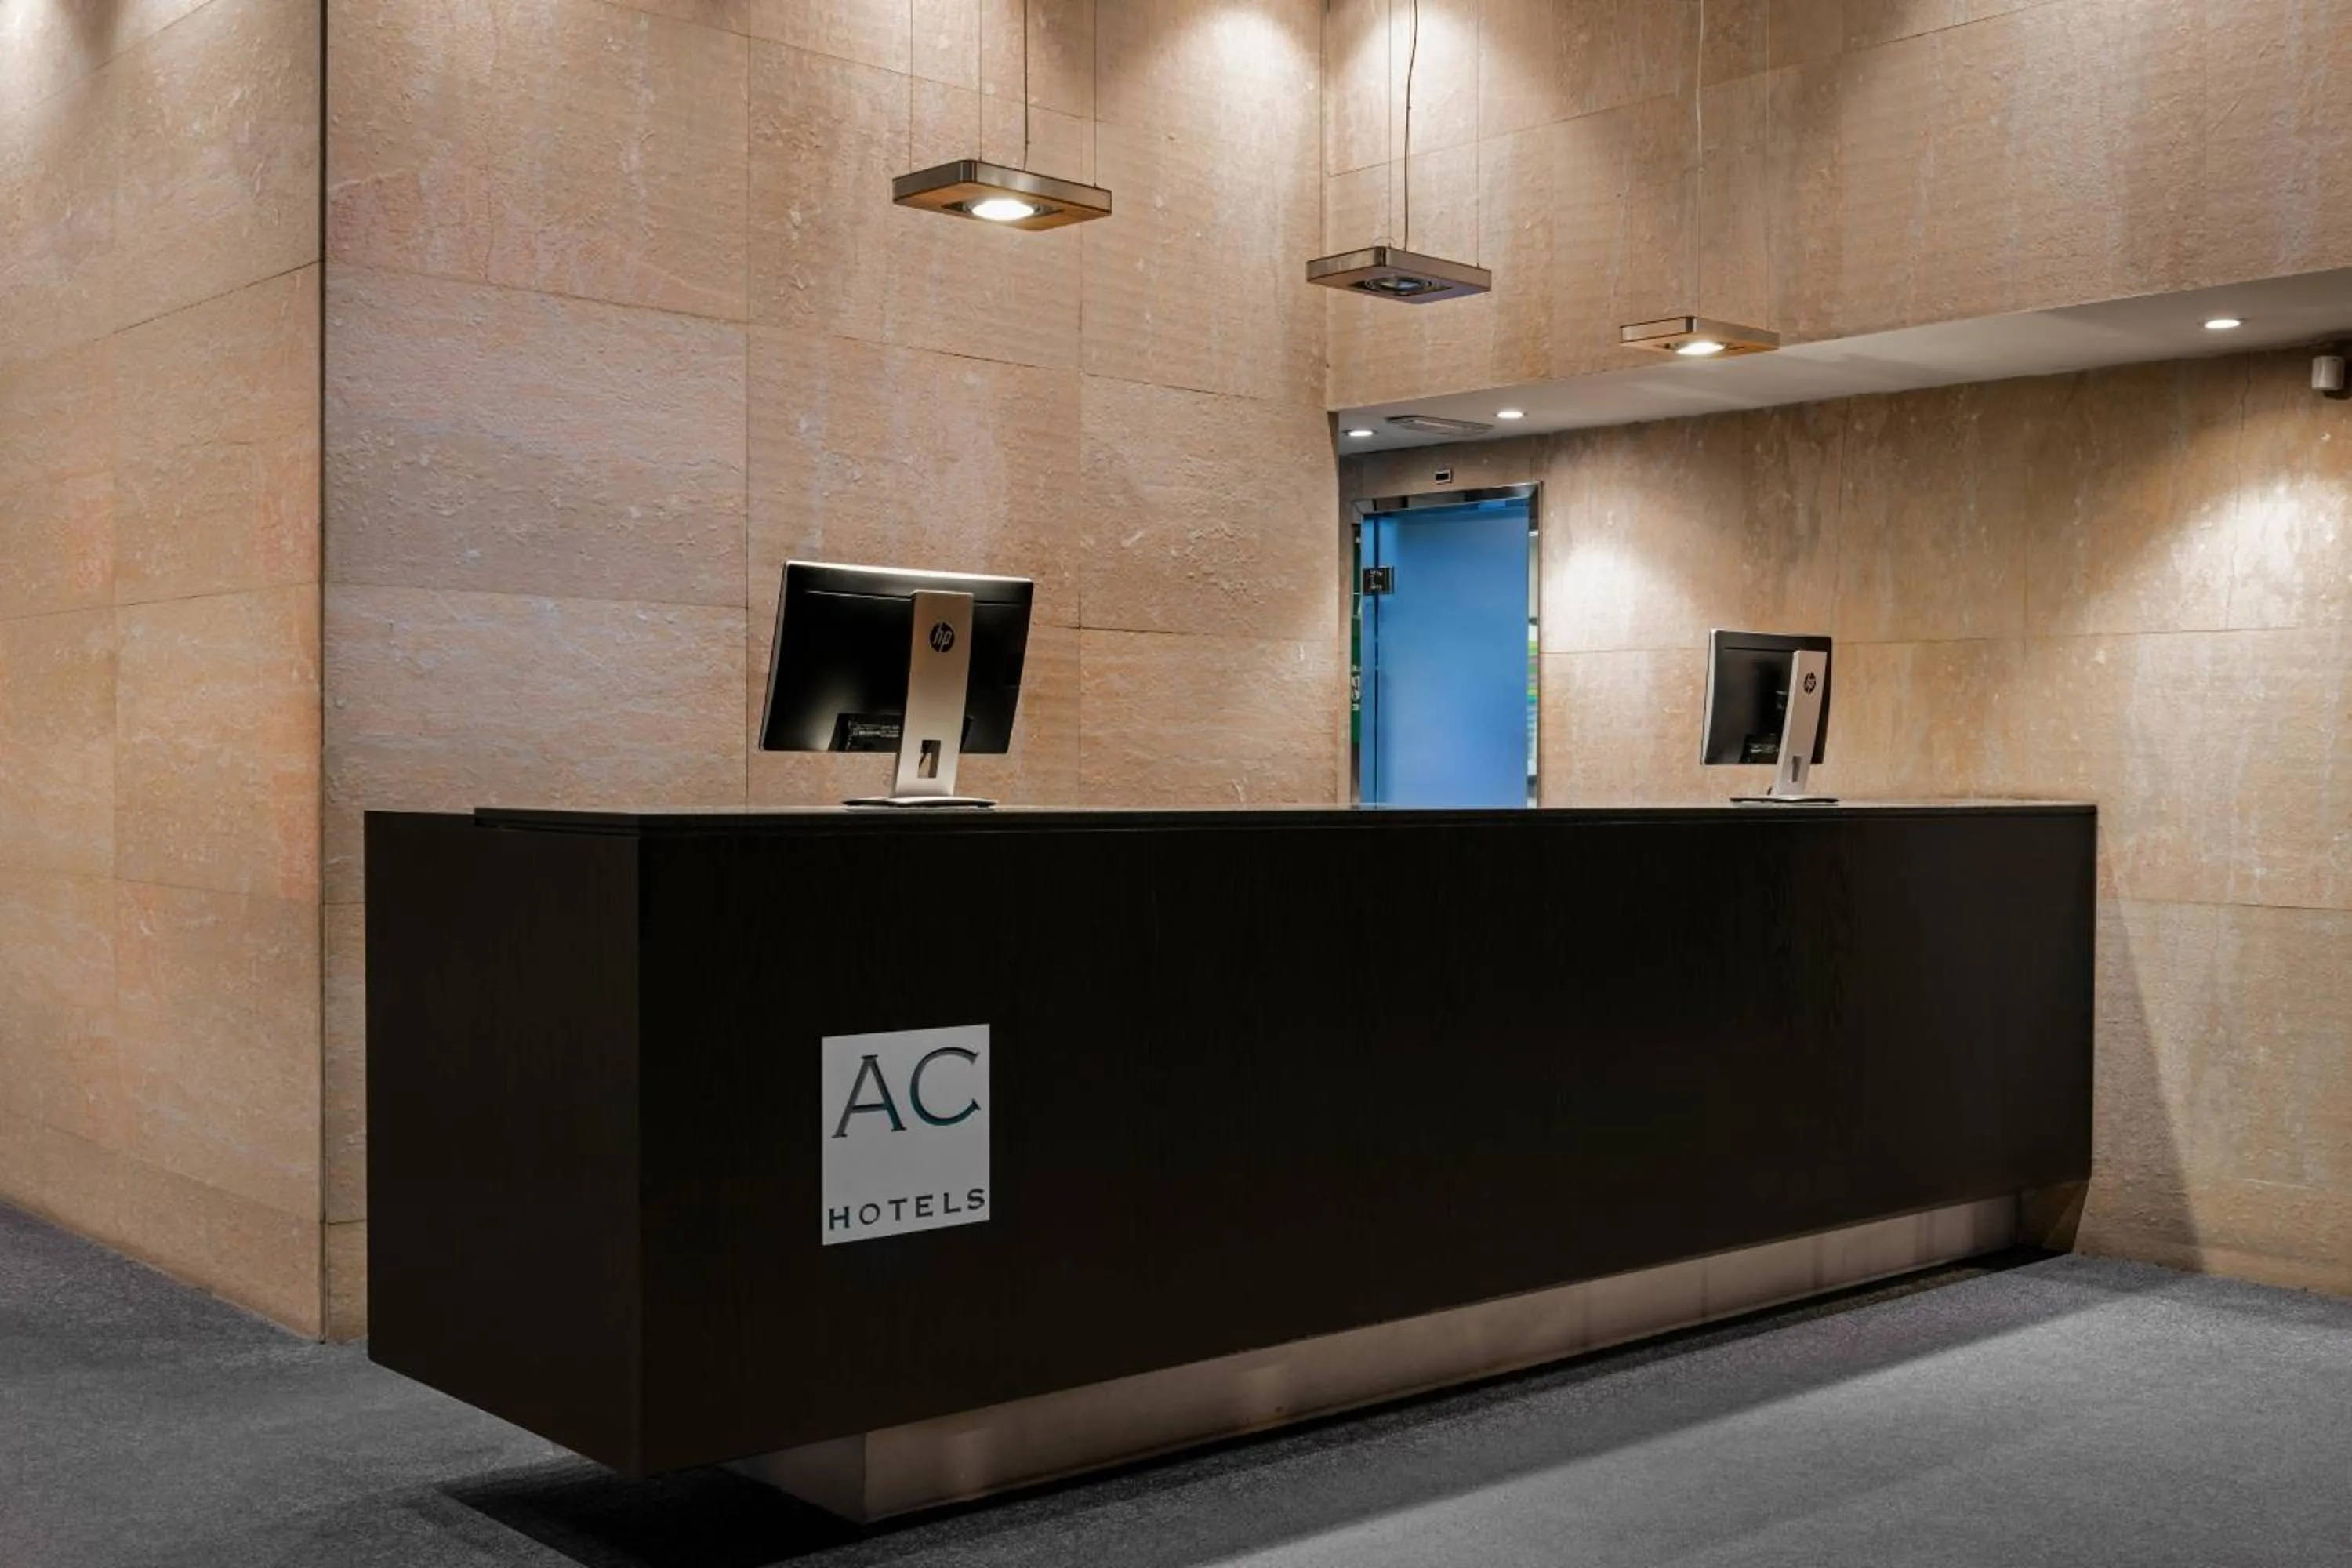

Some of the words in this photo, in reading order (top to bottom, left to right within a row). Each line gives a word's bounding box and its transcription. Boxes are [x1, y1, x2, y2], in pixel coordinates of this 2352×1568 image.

[932, 623, 953, 652] hp
[831, 1047, 981, 1138] AC
[828, 1188, 985, 1231] HOTELS
